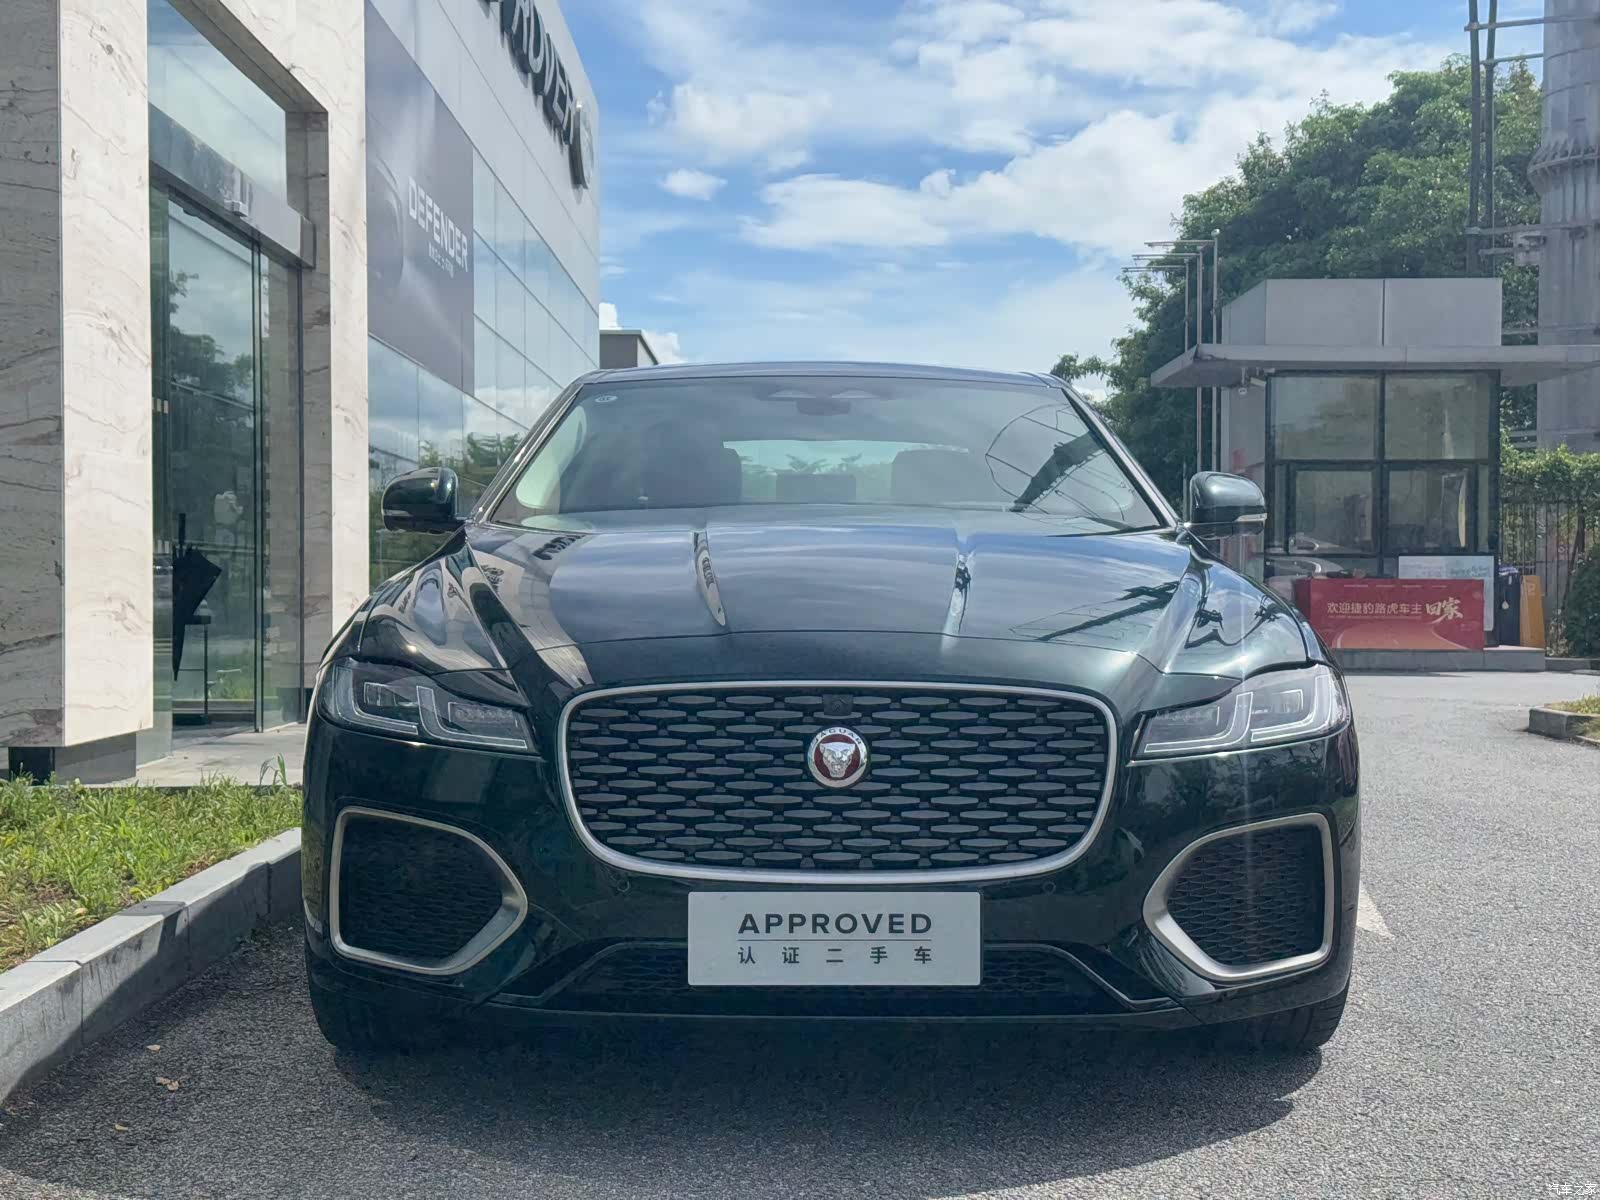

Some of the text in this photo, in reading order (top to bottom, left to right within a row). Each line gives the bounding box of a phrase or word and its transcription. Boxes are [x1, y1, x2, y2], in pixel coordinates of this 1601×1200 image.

[408, 176, 468, 272] DEFENDER
[815, 728, 862, 745] JAGUAR
[738, 913, 932, 934] APPROVED
[738, 946, 932, 965] 认证二手车
